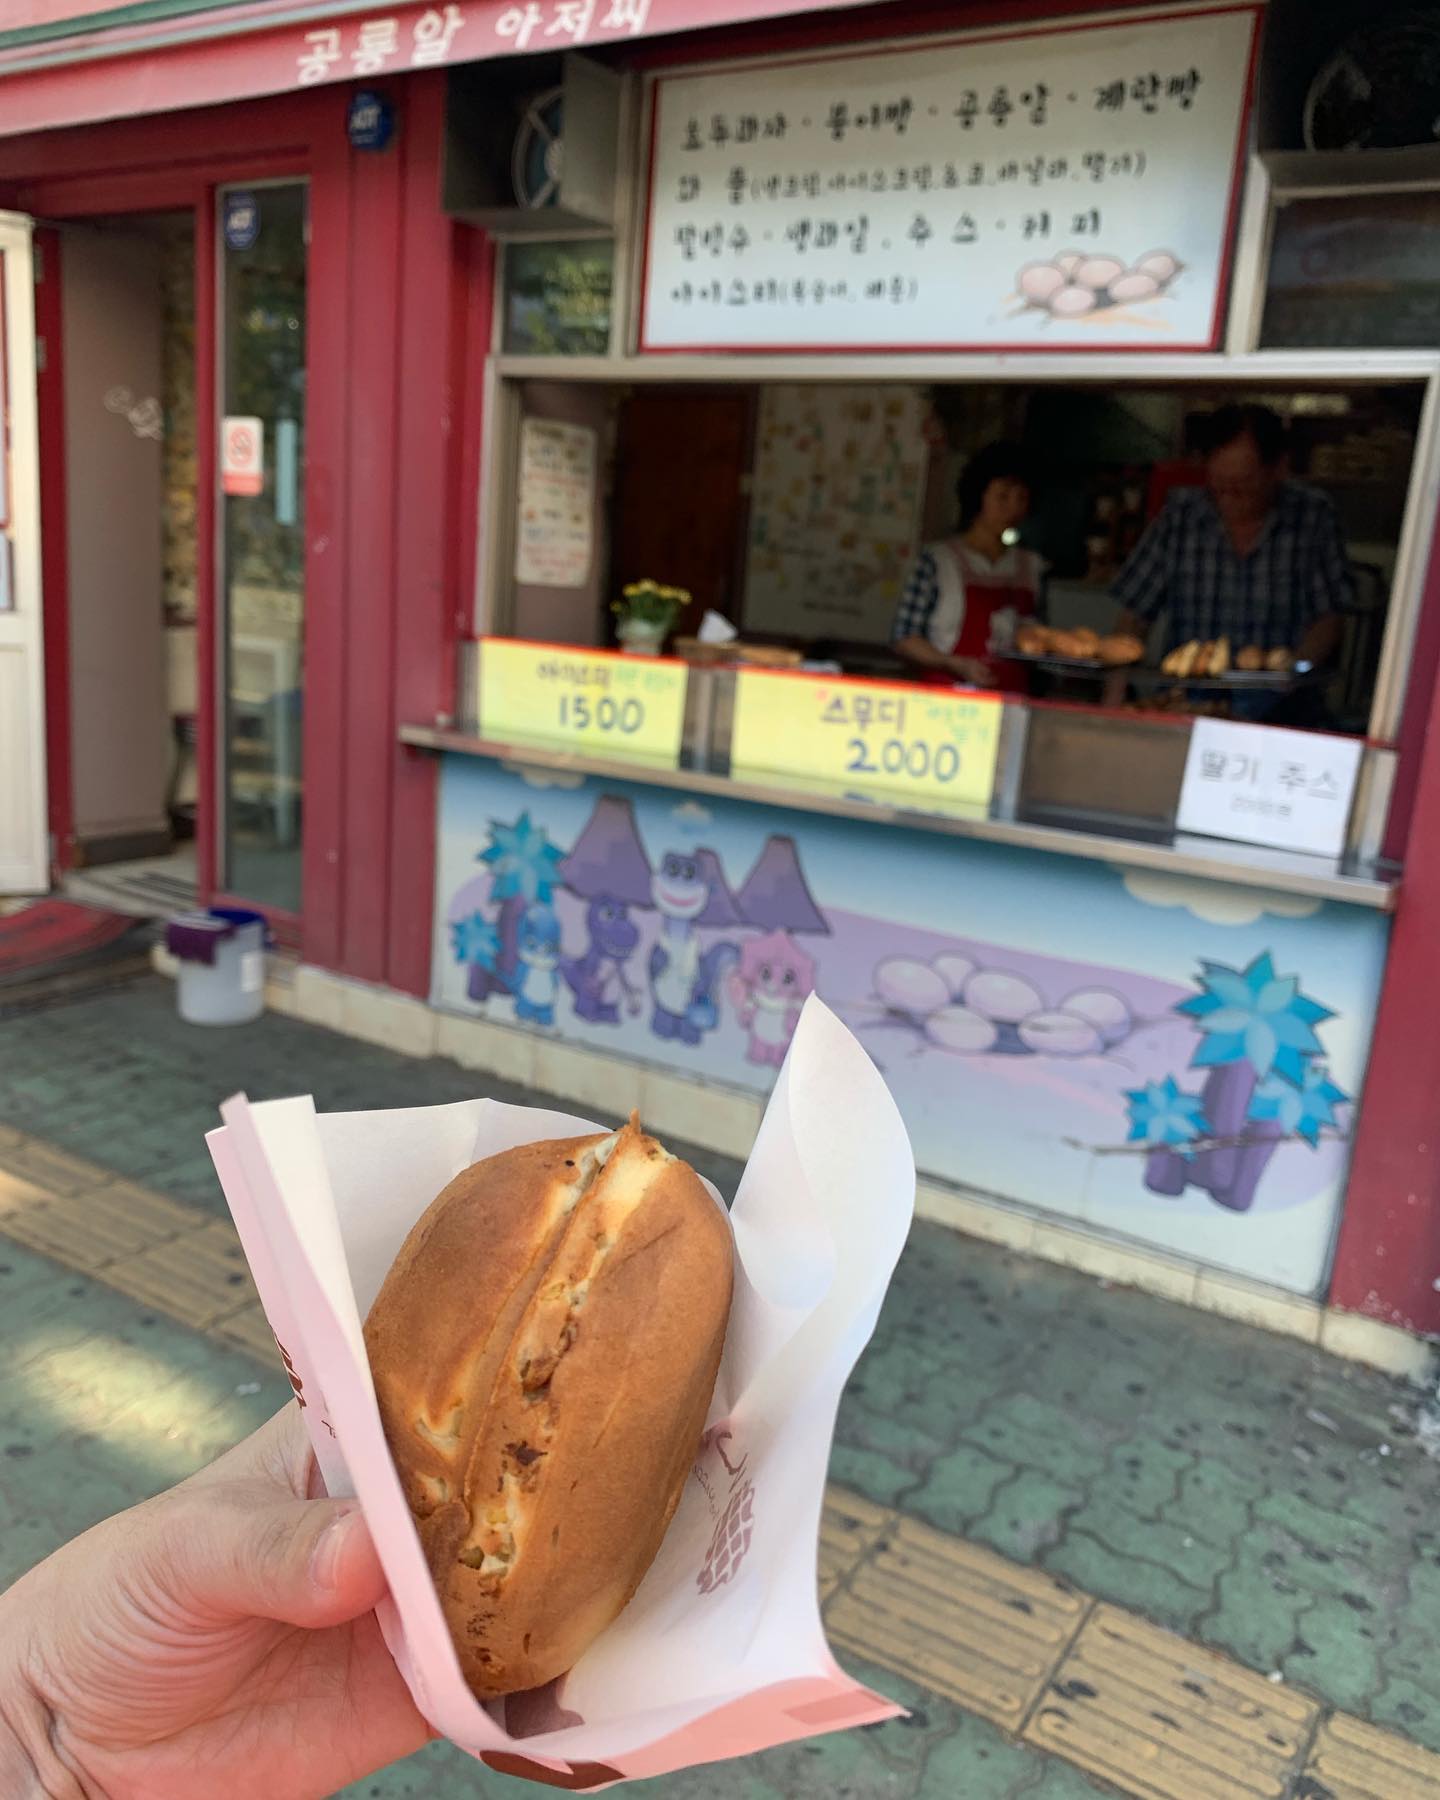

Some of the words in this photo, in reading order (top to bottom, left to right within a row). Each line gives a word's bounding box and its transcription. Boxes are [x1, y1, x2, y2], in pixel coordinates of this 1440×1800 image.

[297, 6, 464, 86] 공룡알
[495, 0, 650, 49] 아저씨
[560, 693, 645, 734] 1500
[821, 695, 906, 735] 스무디
[848, 738, 960, 783] 2000
[1279, 761, 1339, 801] 주스
